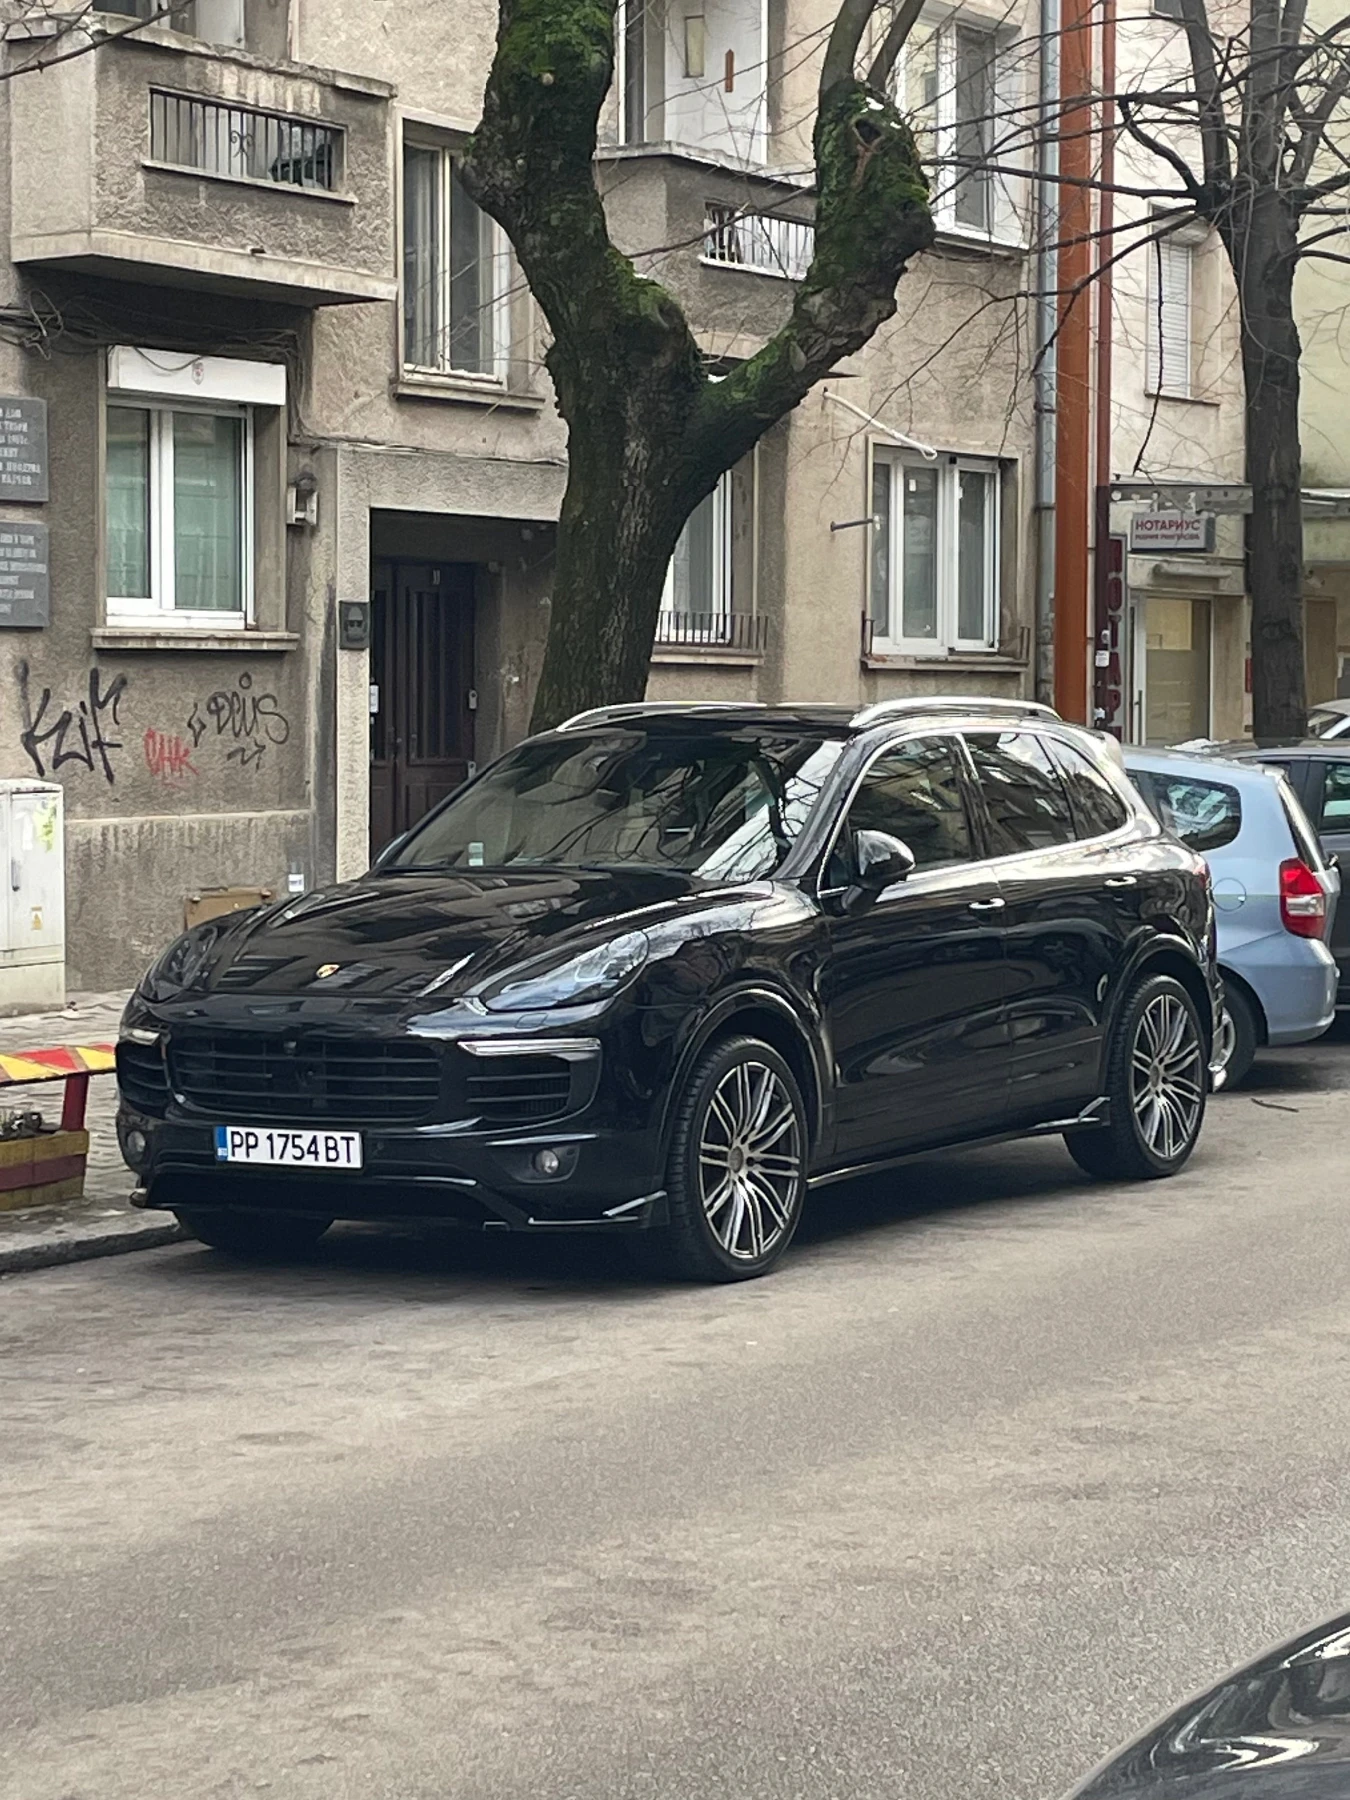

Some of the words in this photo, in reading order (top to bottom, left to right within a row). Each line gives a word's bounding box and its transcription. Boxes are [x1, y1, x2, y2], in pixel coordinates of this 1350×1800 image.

[1135, 519, 1200, 531] НОТАРИУС
[230, 1130, 259, 1159] PP
[266, 1132, 320, 1162] 1754
[324, 1135, 356, 1164] BT
